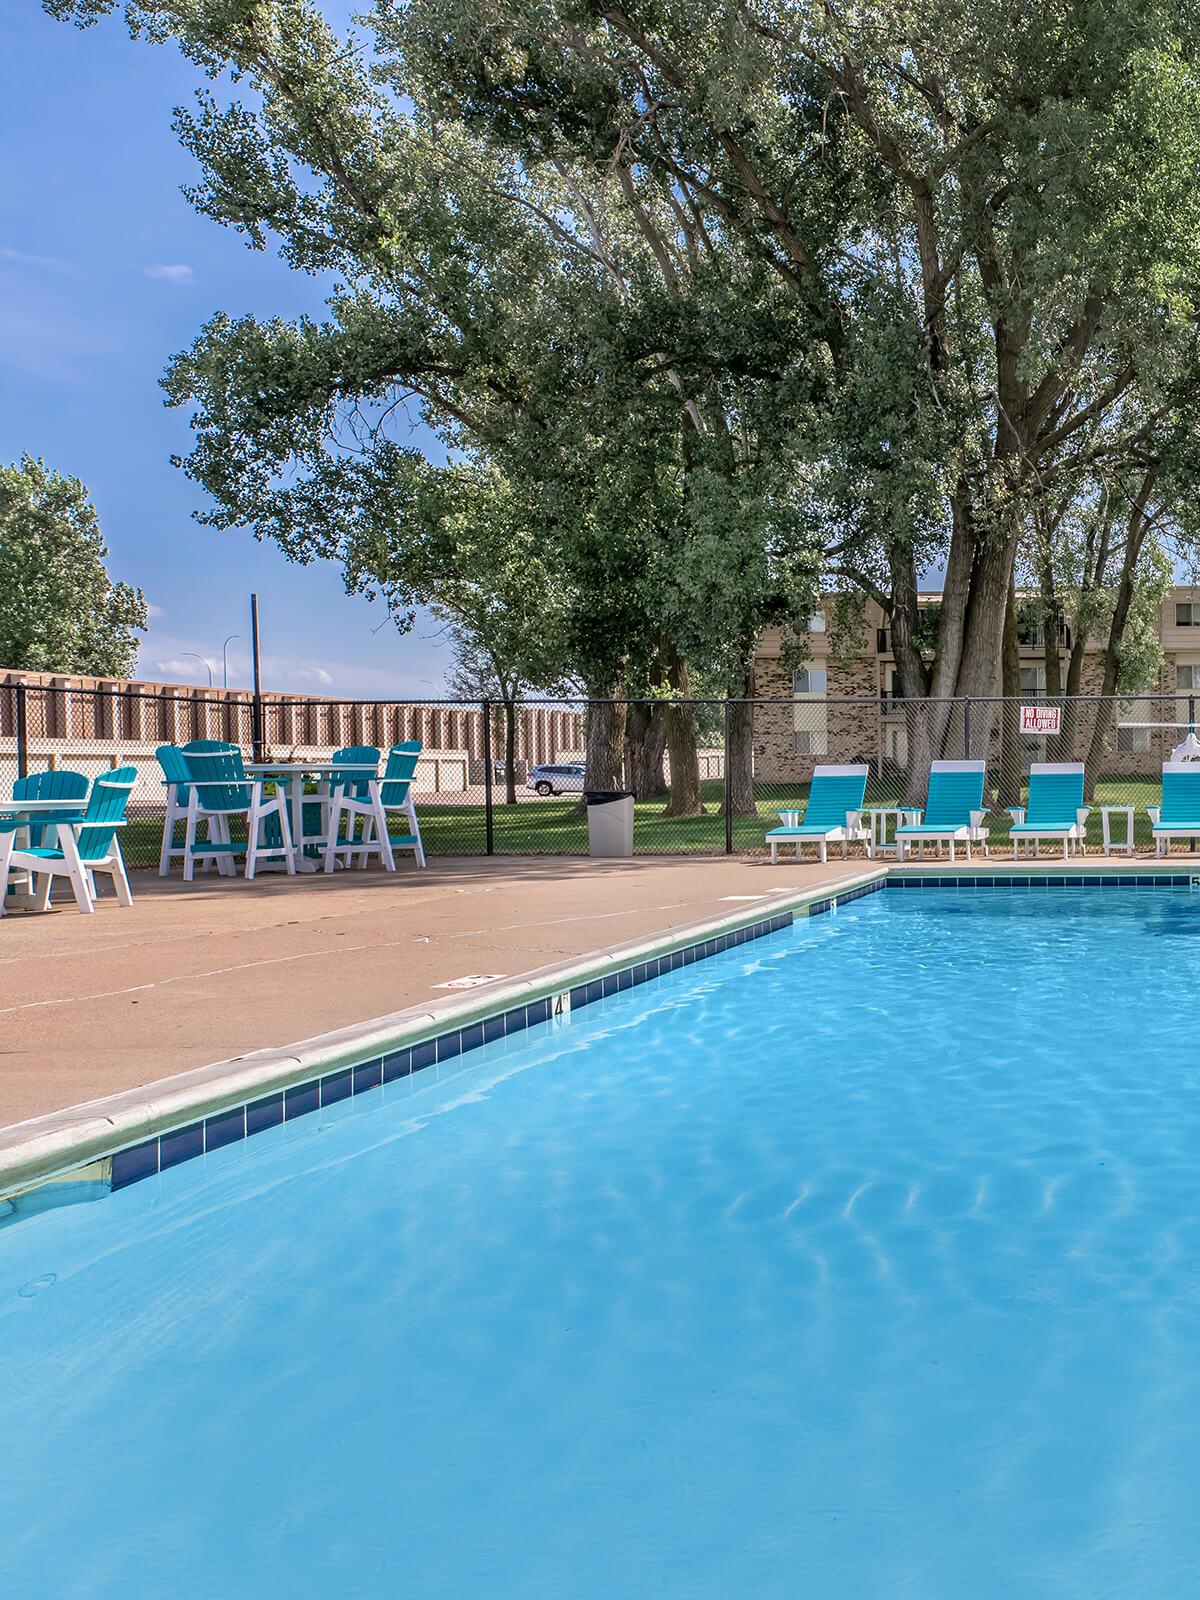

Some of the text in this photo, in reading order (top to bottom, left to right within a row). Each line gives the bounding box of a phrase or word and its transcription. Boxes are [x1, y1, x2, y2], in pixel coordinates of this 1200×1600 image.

[1025, 708, 1057, 719] NO DIVING
[1025, 718, 1056, 729] ALLOWED
[1191, 876, 1200, 886] 5
[554, 994, 564, 1016] 4
